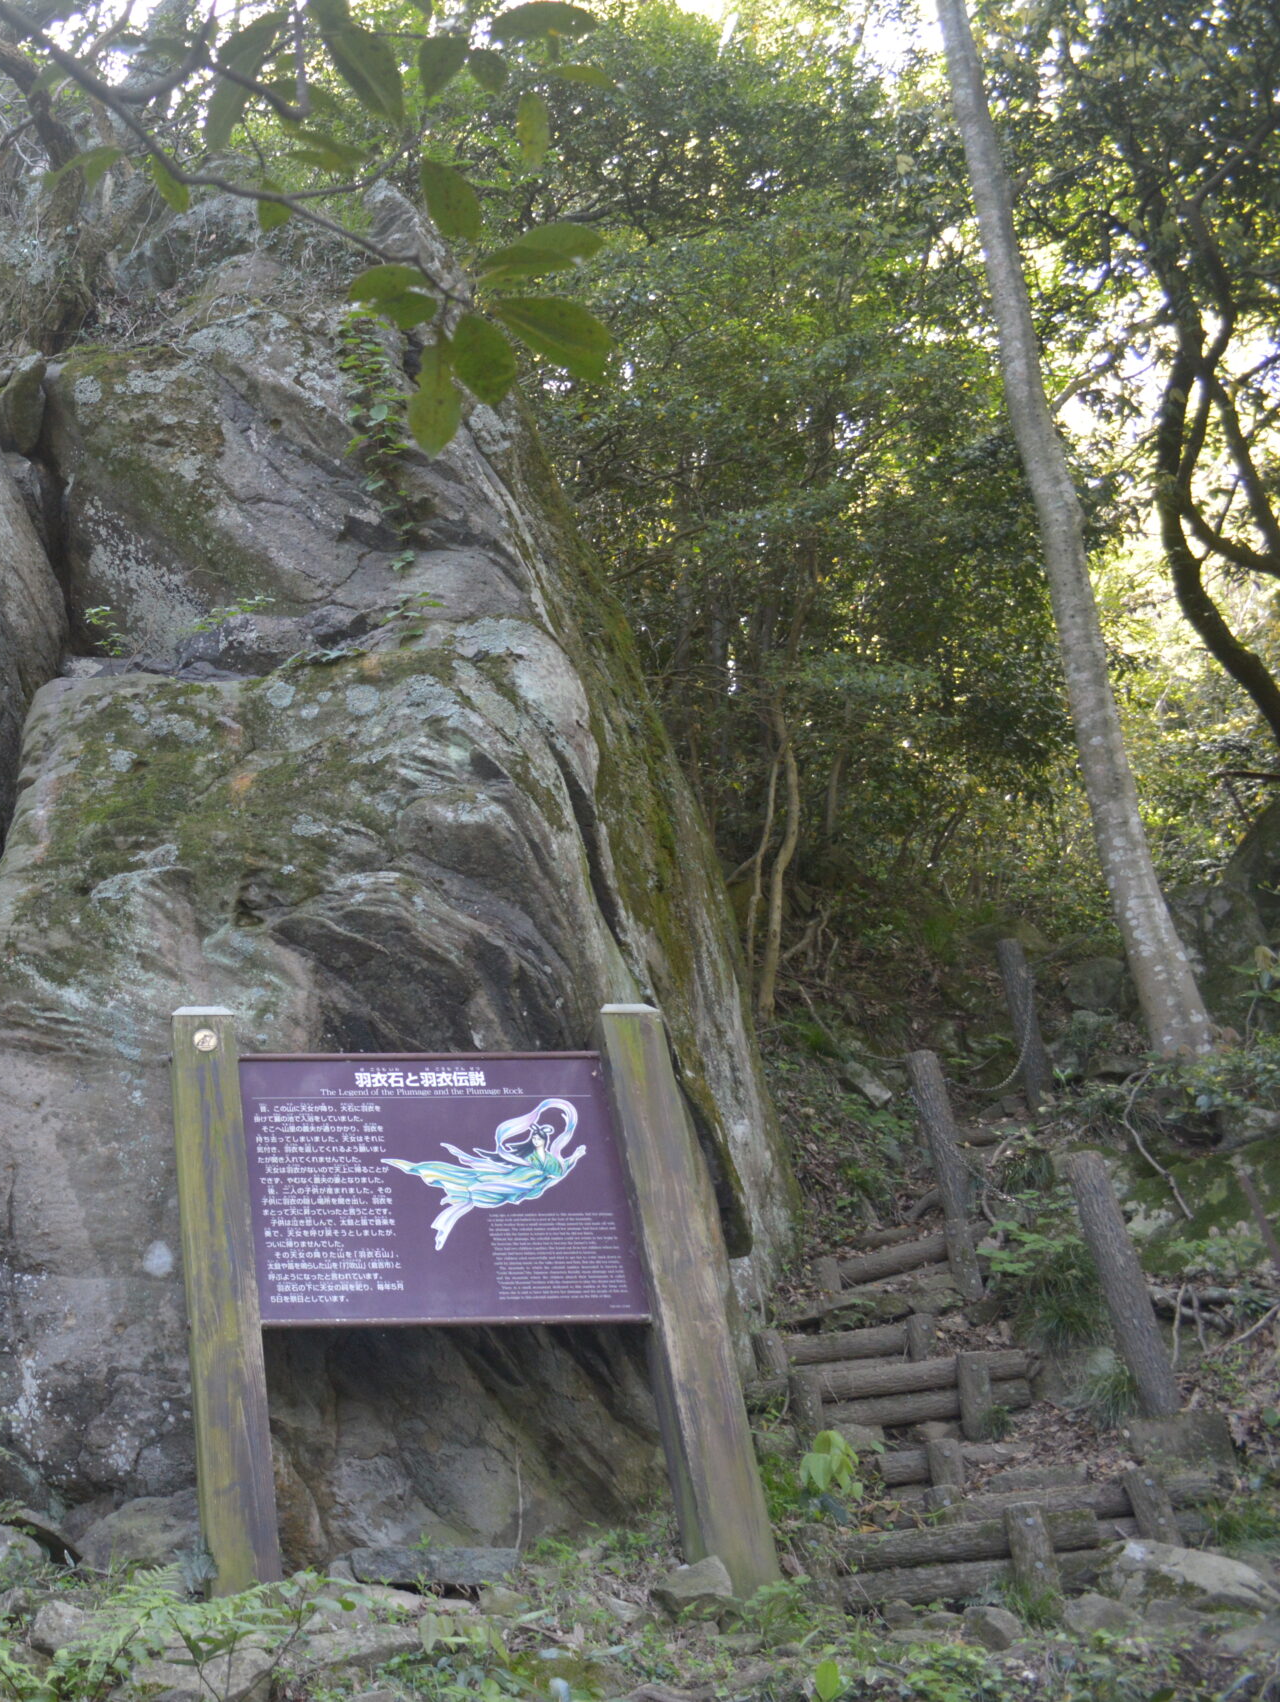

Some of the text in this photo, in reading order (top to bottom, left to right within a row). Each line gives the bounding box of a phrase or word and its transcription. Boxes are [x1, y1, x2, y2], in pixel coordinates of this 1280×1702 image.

[354, 1071, 486, 1087] 羽衣石と羽衣伝説
[321, 1087, 524, 1097] The Legend of the Plumage and the Plumage Rock
[255, 1135, 385, 1144] 持ち去ってしまいました。天女はそれに
[265, 1240, 345, 1248] ついに帰りませんでした。
[268, 1273, 383, 1281] 呼ぶようになったと言われています。
